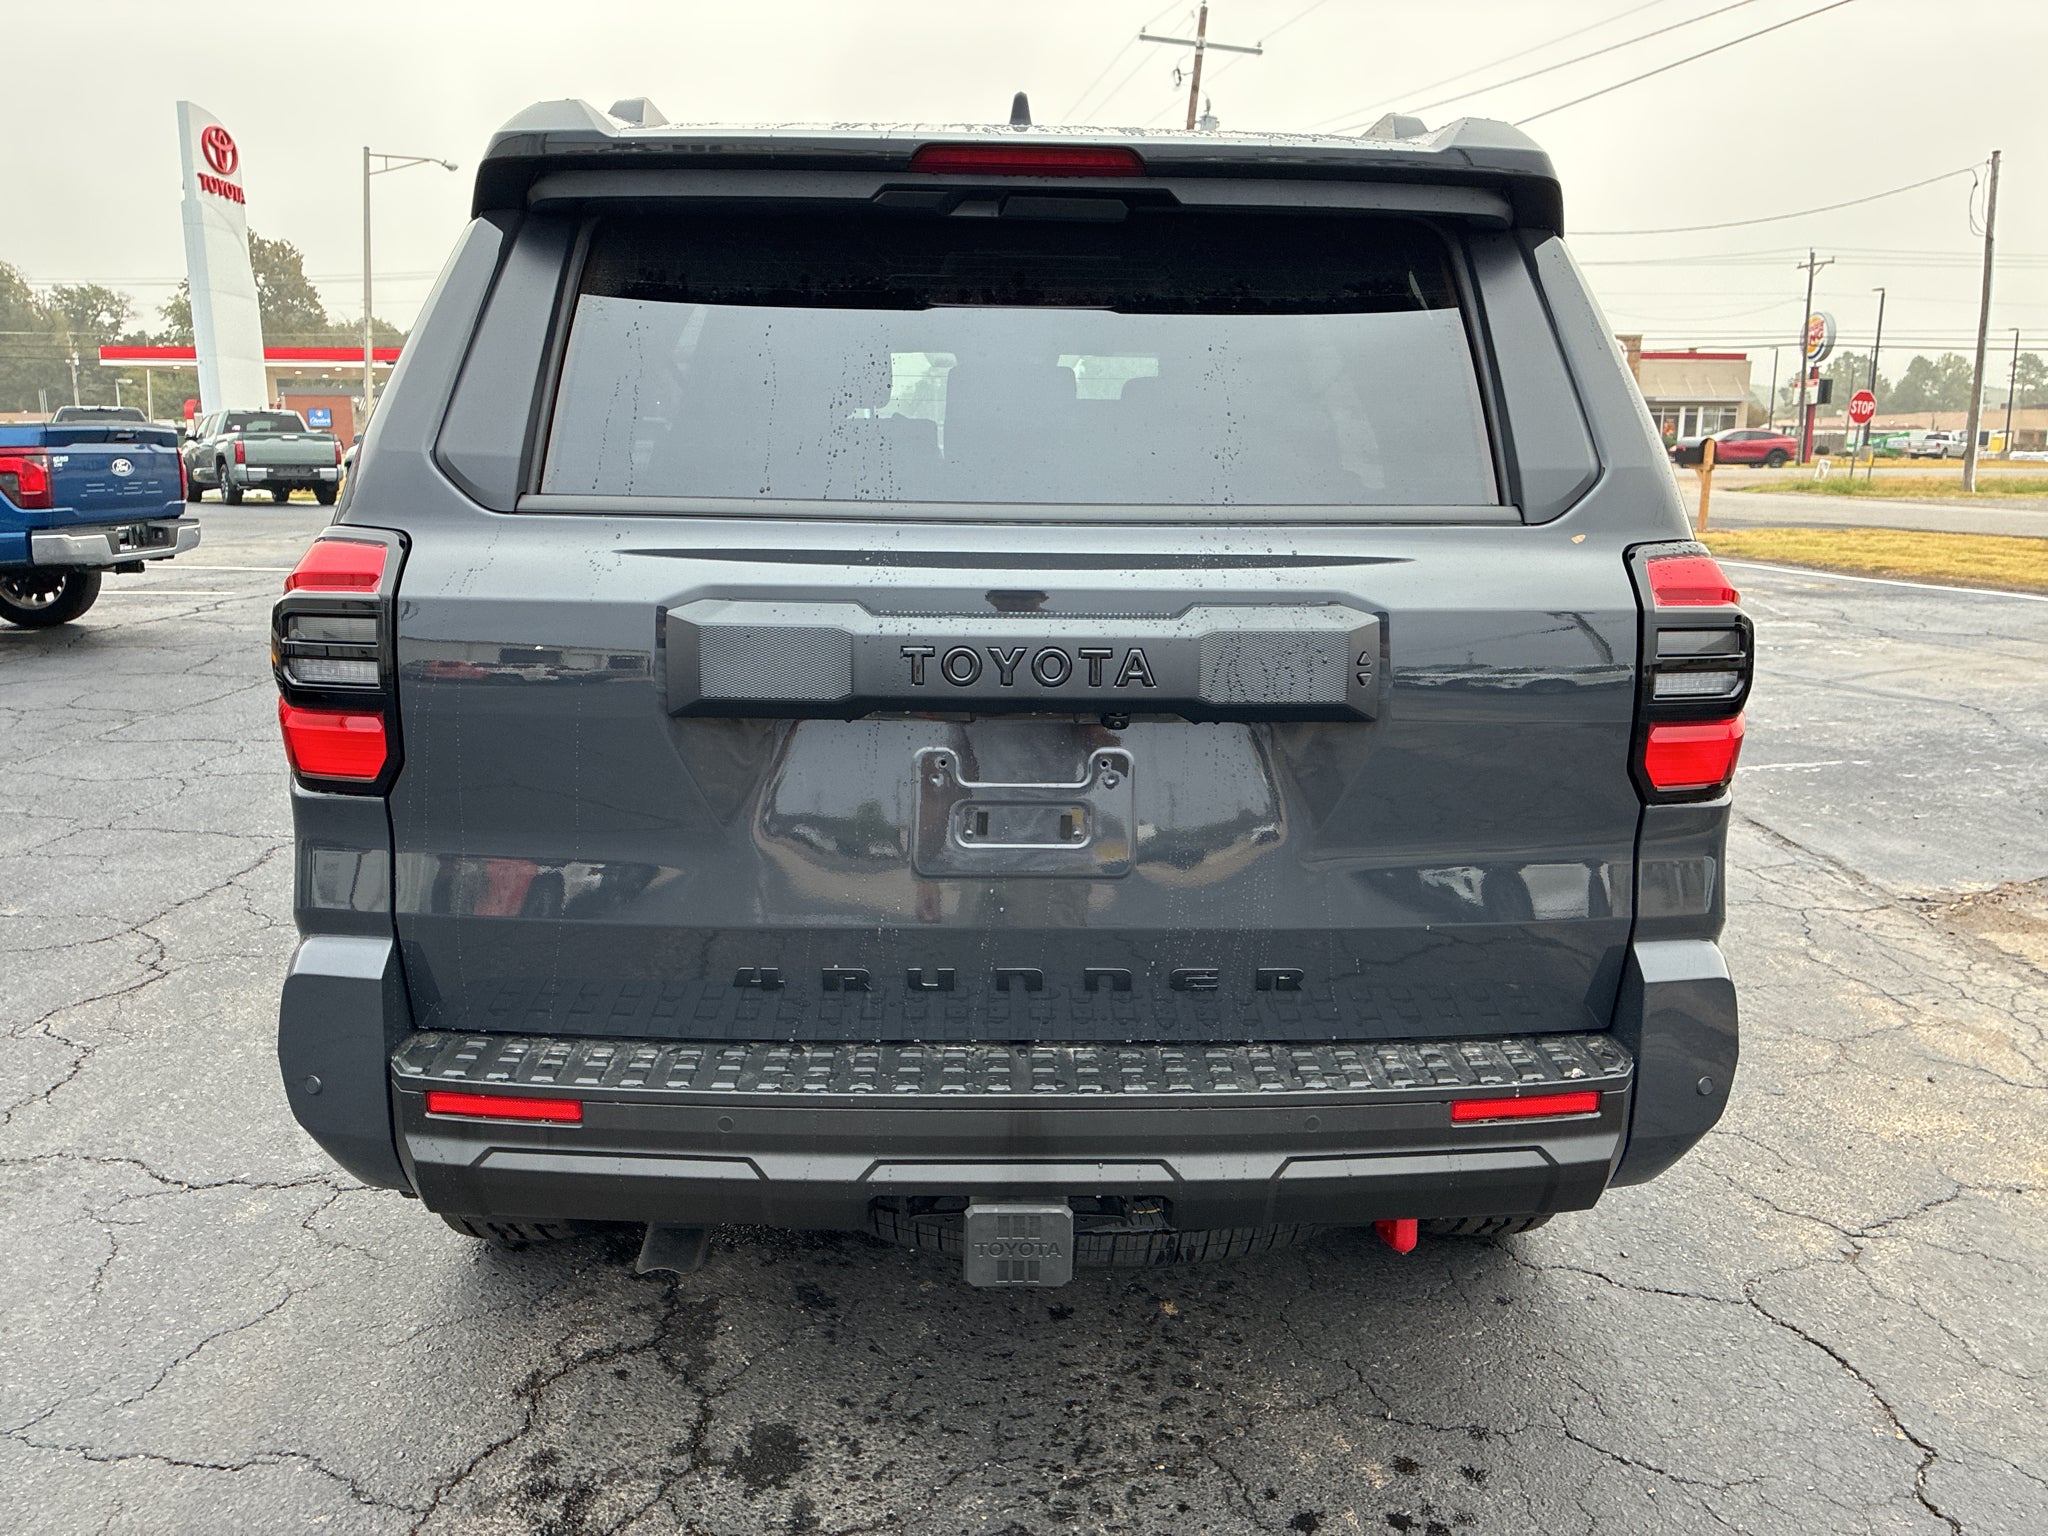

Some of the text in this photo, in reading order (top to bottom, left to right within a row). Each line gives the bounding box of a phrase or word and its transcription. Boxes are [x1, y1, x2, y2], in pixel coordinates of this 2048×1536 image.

[197, 172, 246, 205] TOYOTA
[1850, 400, 1874, 415] STOP
[900, 645, 1157, 687] TOYOTA
[732, 967, 1305, 992] 4RUNNER
[974, 1242, 1062, 1258] TOYOTA
